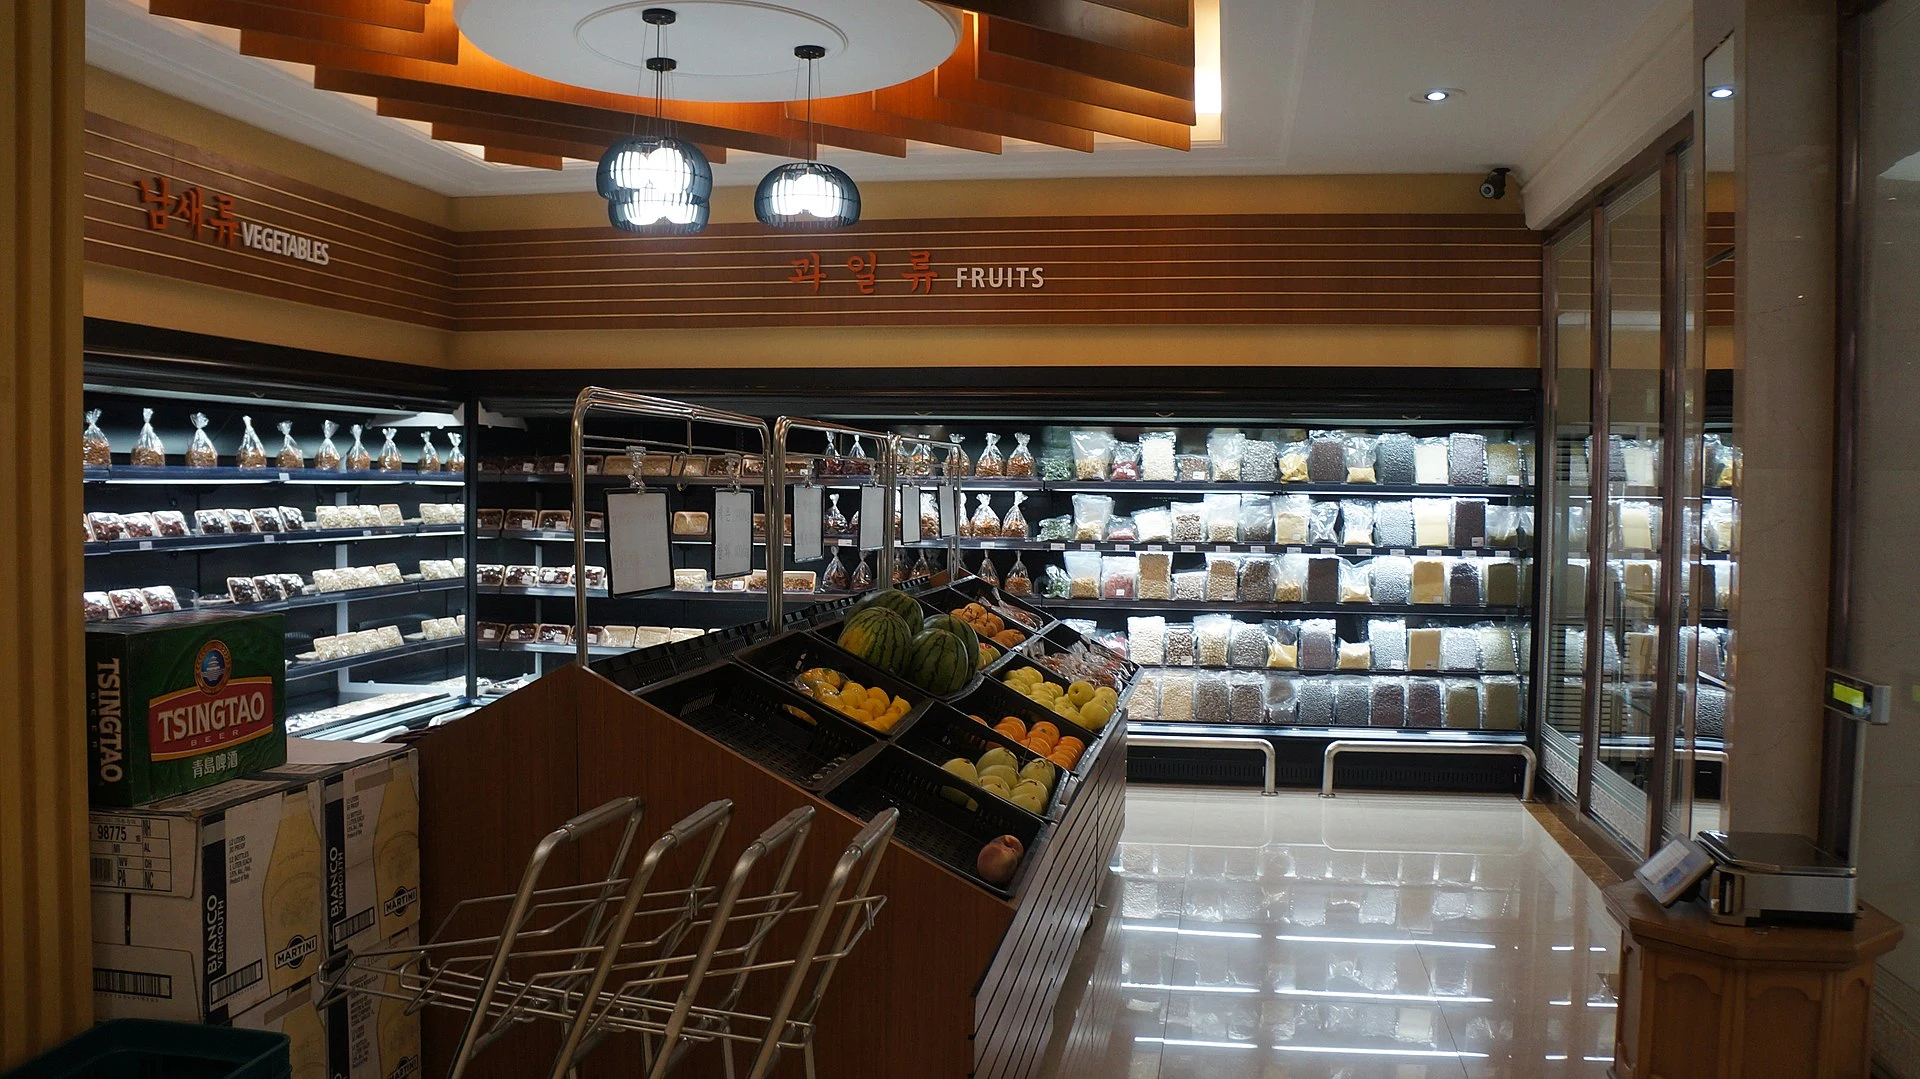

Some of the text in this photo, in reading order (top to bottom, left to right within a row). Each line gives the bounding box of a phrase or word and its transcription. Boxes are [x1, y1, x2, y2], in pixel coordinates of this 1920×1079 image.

[137, 177, 240, 247] 남새류
[240, 221, 329, 265] VEGETABLES
[956, 266, 1044, 289] FRUITS
[97, 657, 123, 783] TSINGTAO
[157, 691, 265, 743] TSINGTAO
[190, 729, 239, 747] BEER
[192, 751, 238, 779] 青島啤酒
[97, 824, 127, 841] 98775
[330, 846, 339, 918] BIANCO
[386, 891, 417, 914] MARTINI
[207, 894, 218, 975] BIANCO
[217, 900, 225, 969] VERMOUTH
[276, 939, 316, 967] MARTINI
